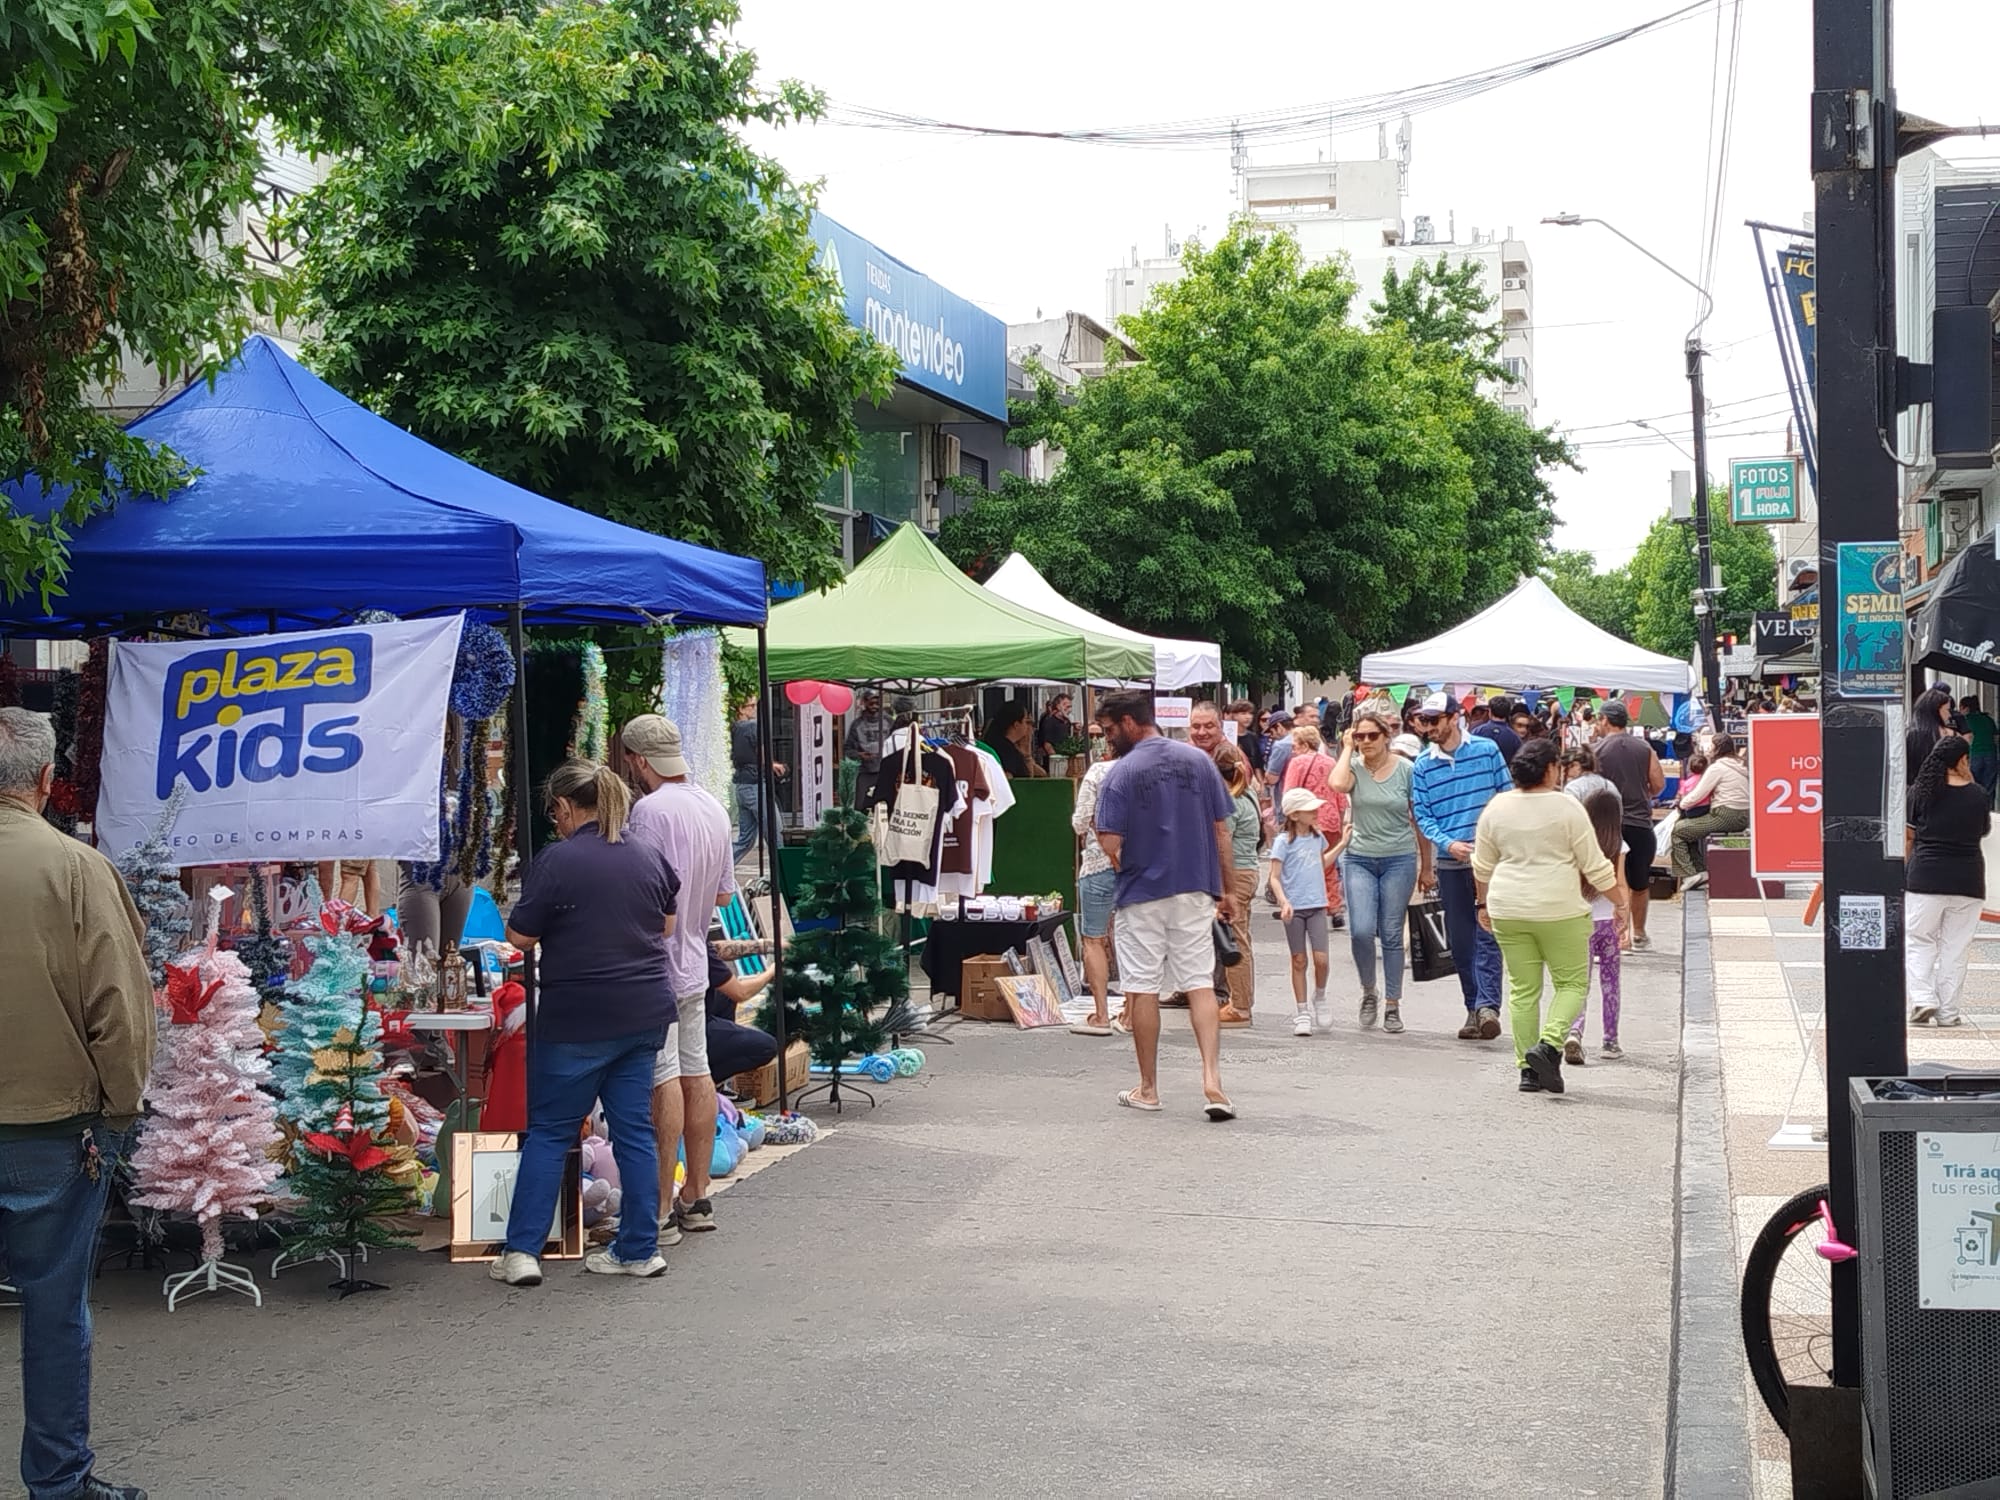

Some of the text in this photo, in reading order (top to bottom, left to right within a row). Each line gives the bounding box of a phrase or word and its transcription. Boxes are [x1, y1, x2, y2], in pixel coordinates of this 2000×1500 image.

[866, 261, 891, 294] TIENDAS
[865, 297, 964, 385] montevideo
[1740, 468, 1789, 484] FOTOS
[1739, 489, 1791, 516] 1 HORA
[1756, 486, 1790, 499] FUJI
[177, 647, 356, 720] plaza
[157, 703, 363, 800] kids
[1766, 779, 1822, 814] 25
[135, 829, 364, 848] PSEO DE COMPRAS
[1943, 1164, 2000, 1182] Tirá aq
[1932, 1183, 1957, 1195] tus
